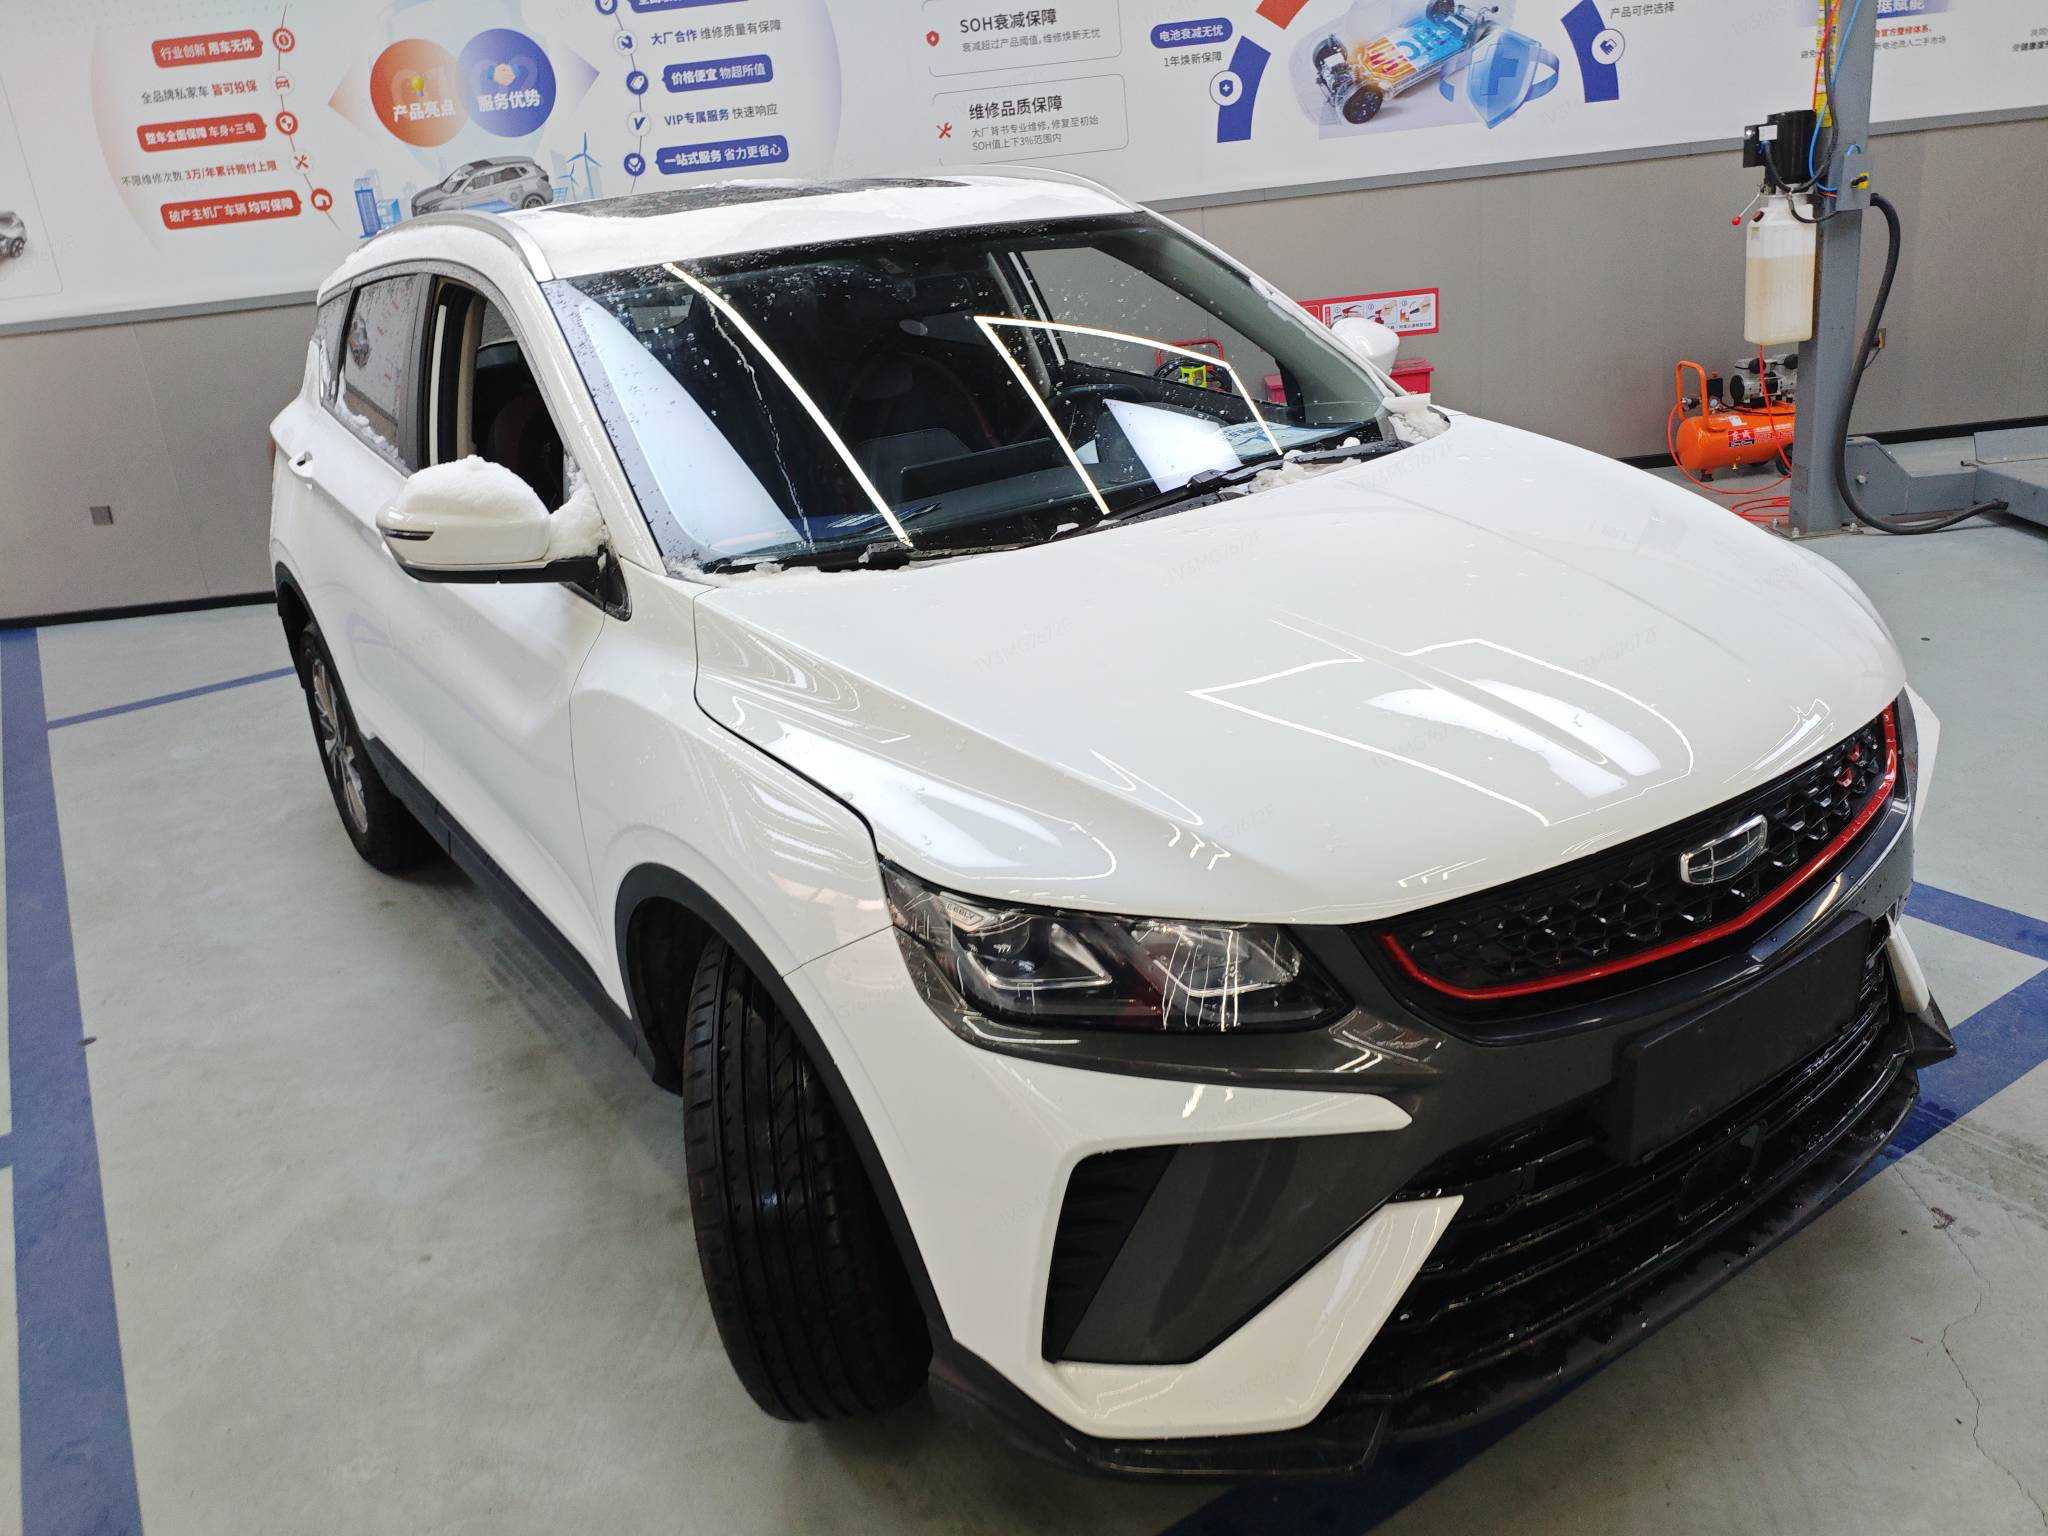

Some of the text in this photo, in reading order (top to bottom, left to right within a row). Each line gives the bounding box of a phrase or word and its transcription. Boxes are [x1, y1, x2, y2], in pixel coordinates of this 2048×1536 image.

[959, 8, 1058, 34] SOH衰减保障
[1610, 1, 1675, 19] 产品可供选择
[651, 19, 782, 46] 大厂合作 维修质量有保障
[1160, 24, 1224, 42] 电池衰减无忧
[160, 43, 206, 61] 行业创新
[671, 62, 766, 86] 价格便宜 物超所值
[211, 80, 258, 97] 皆可投保
[477, 88, 541, 112] 服务优势
[393, 99, 456, 122] 产品亮点
[664, 103, 778, 126] VIP专属服务 快速响应
[969, 95, 1063, 121] 维修品质保障
[664, 143, 782, 167] 一站式服务 省力更省心
